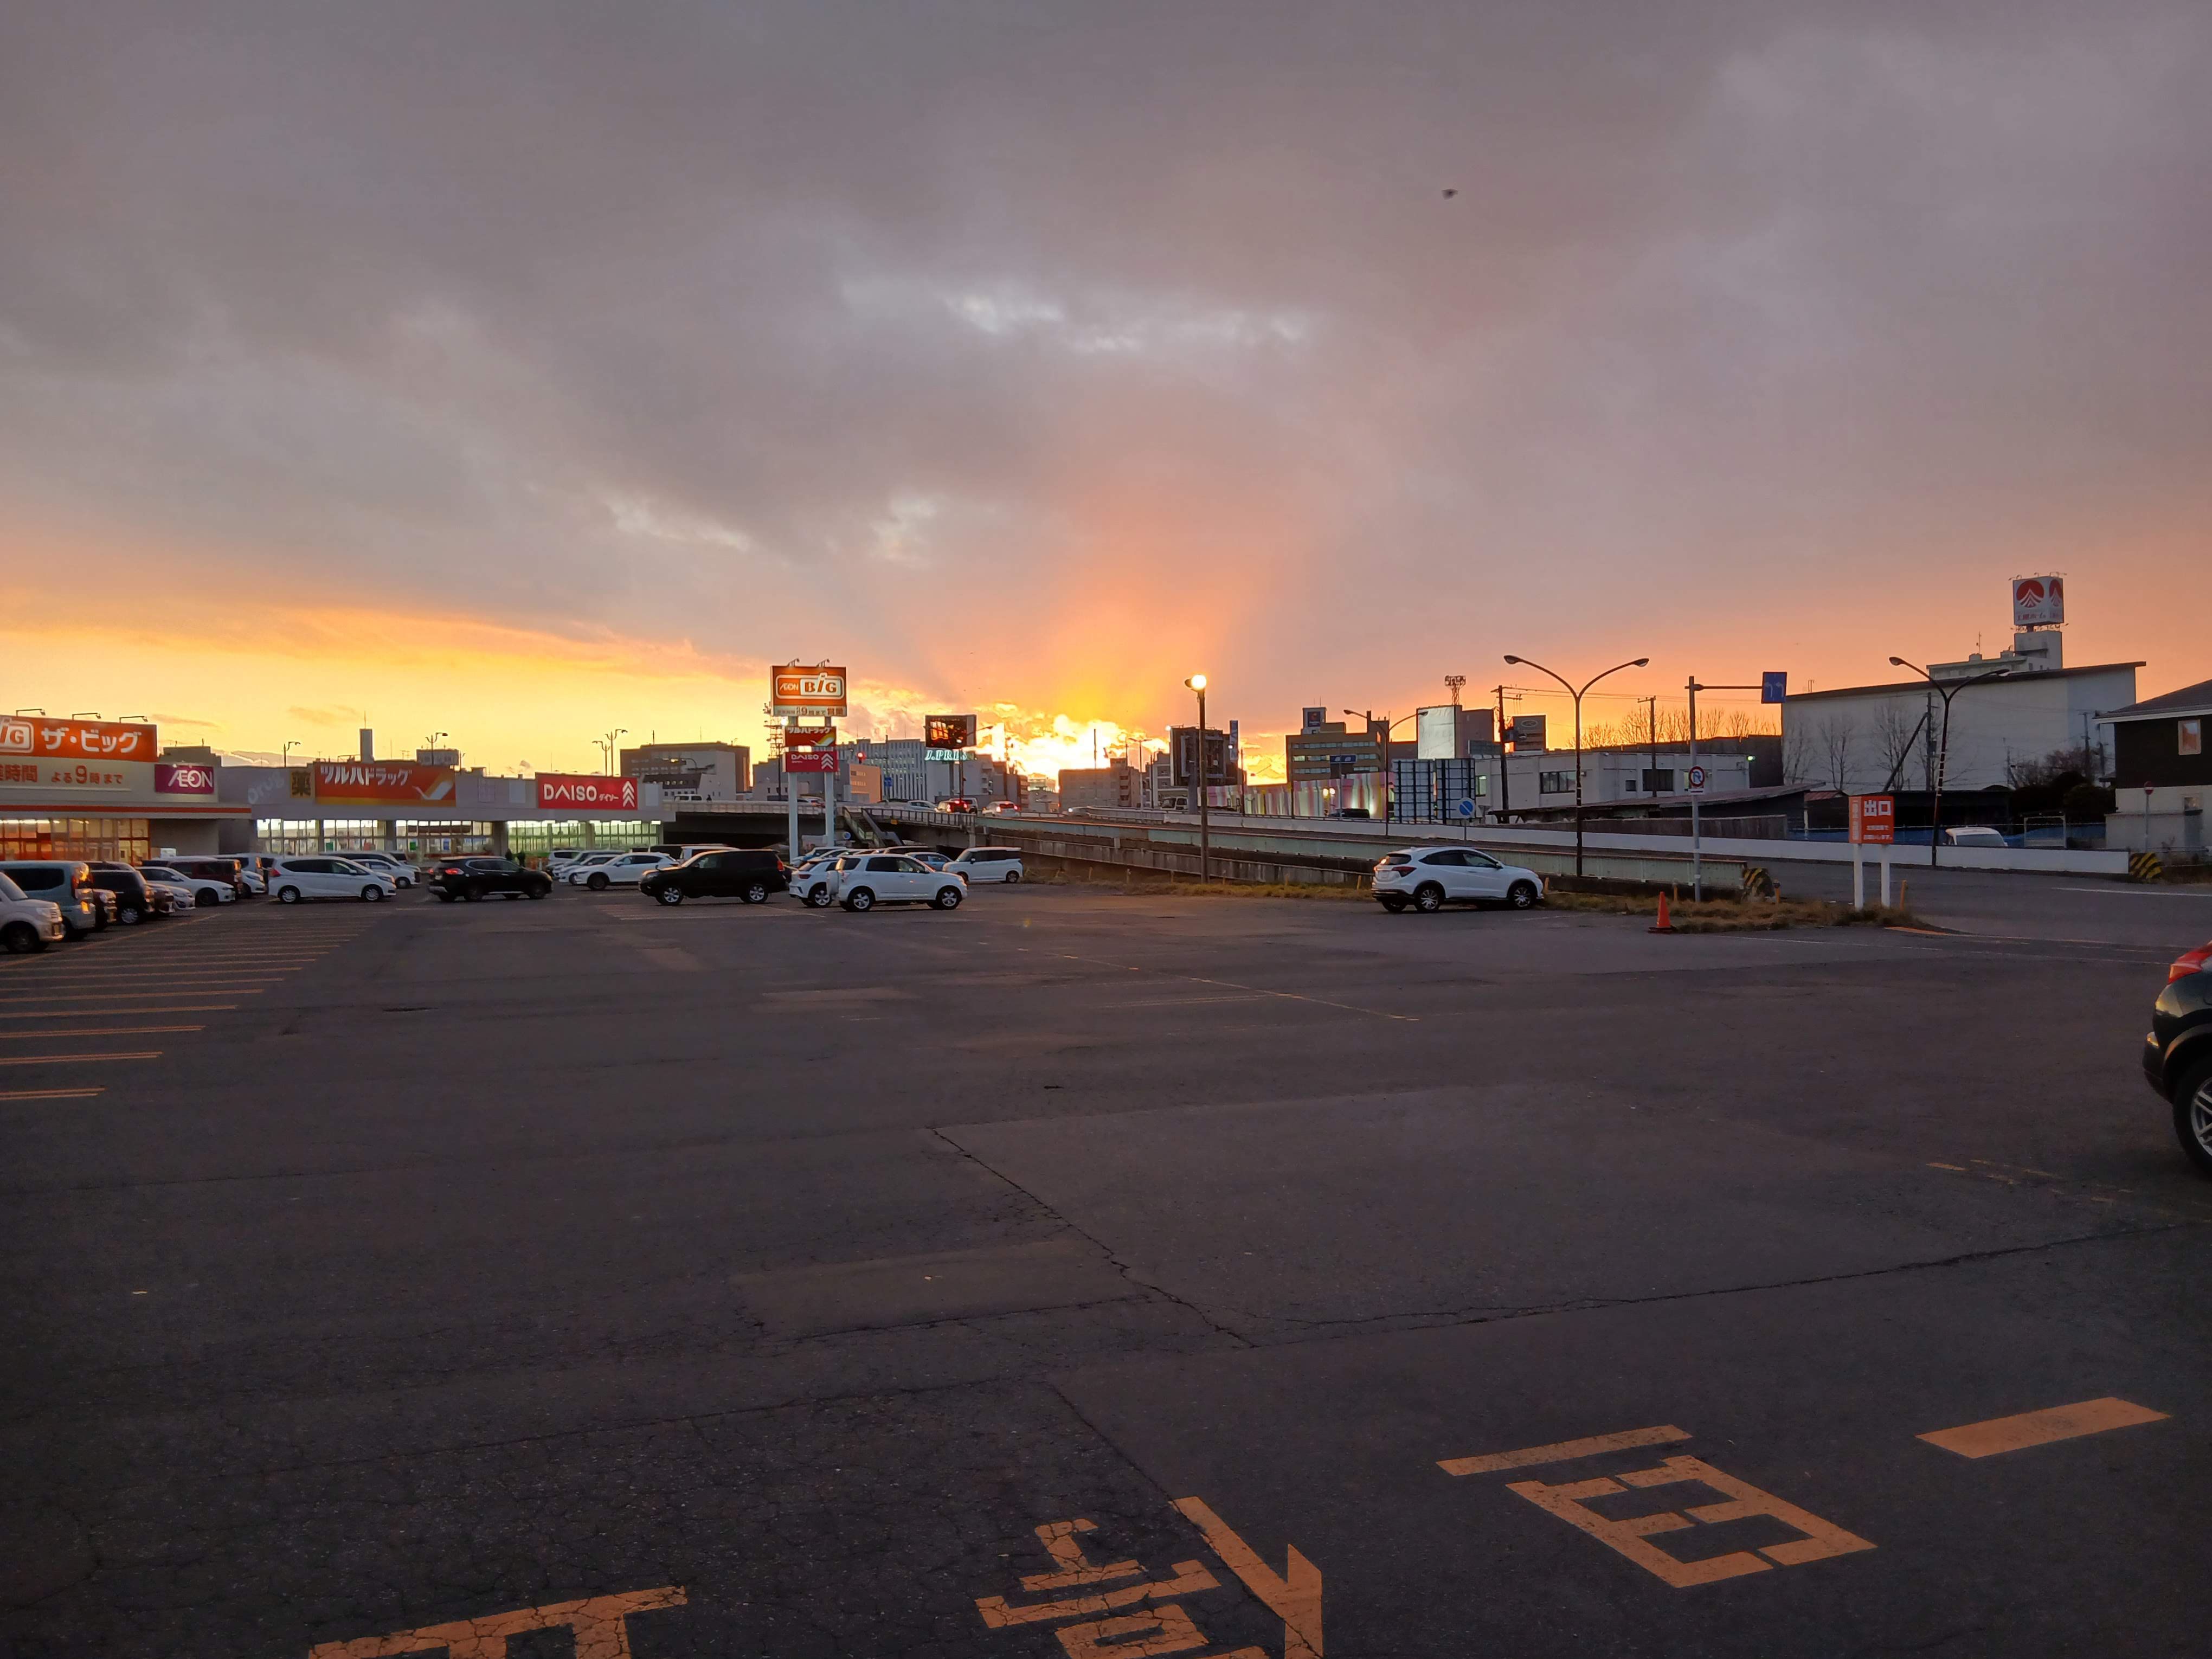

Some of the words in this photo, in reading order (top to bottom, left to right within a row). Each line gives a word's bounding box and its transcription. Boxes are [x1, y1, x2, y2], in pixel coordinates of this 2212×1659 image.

[41, 727, 142, 753] ザ・ビッグ
[0, 764, 38, 782] 時間
[320, 765, 412, 786] ツルハドラッグ
[544, 784, 597, 801] DAISO
[1864, 800, 1891, 816] 出口
